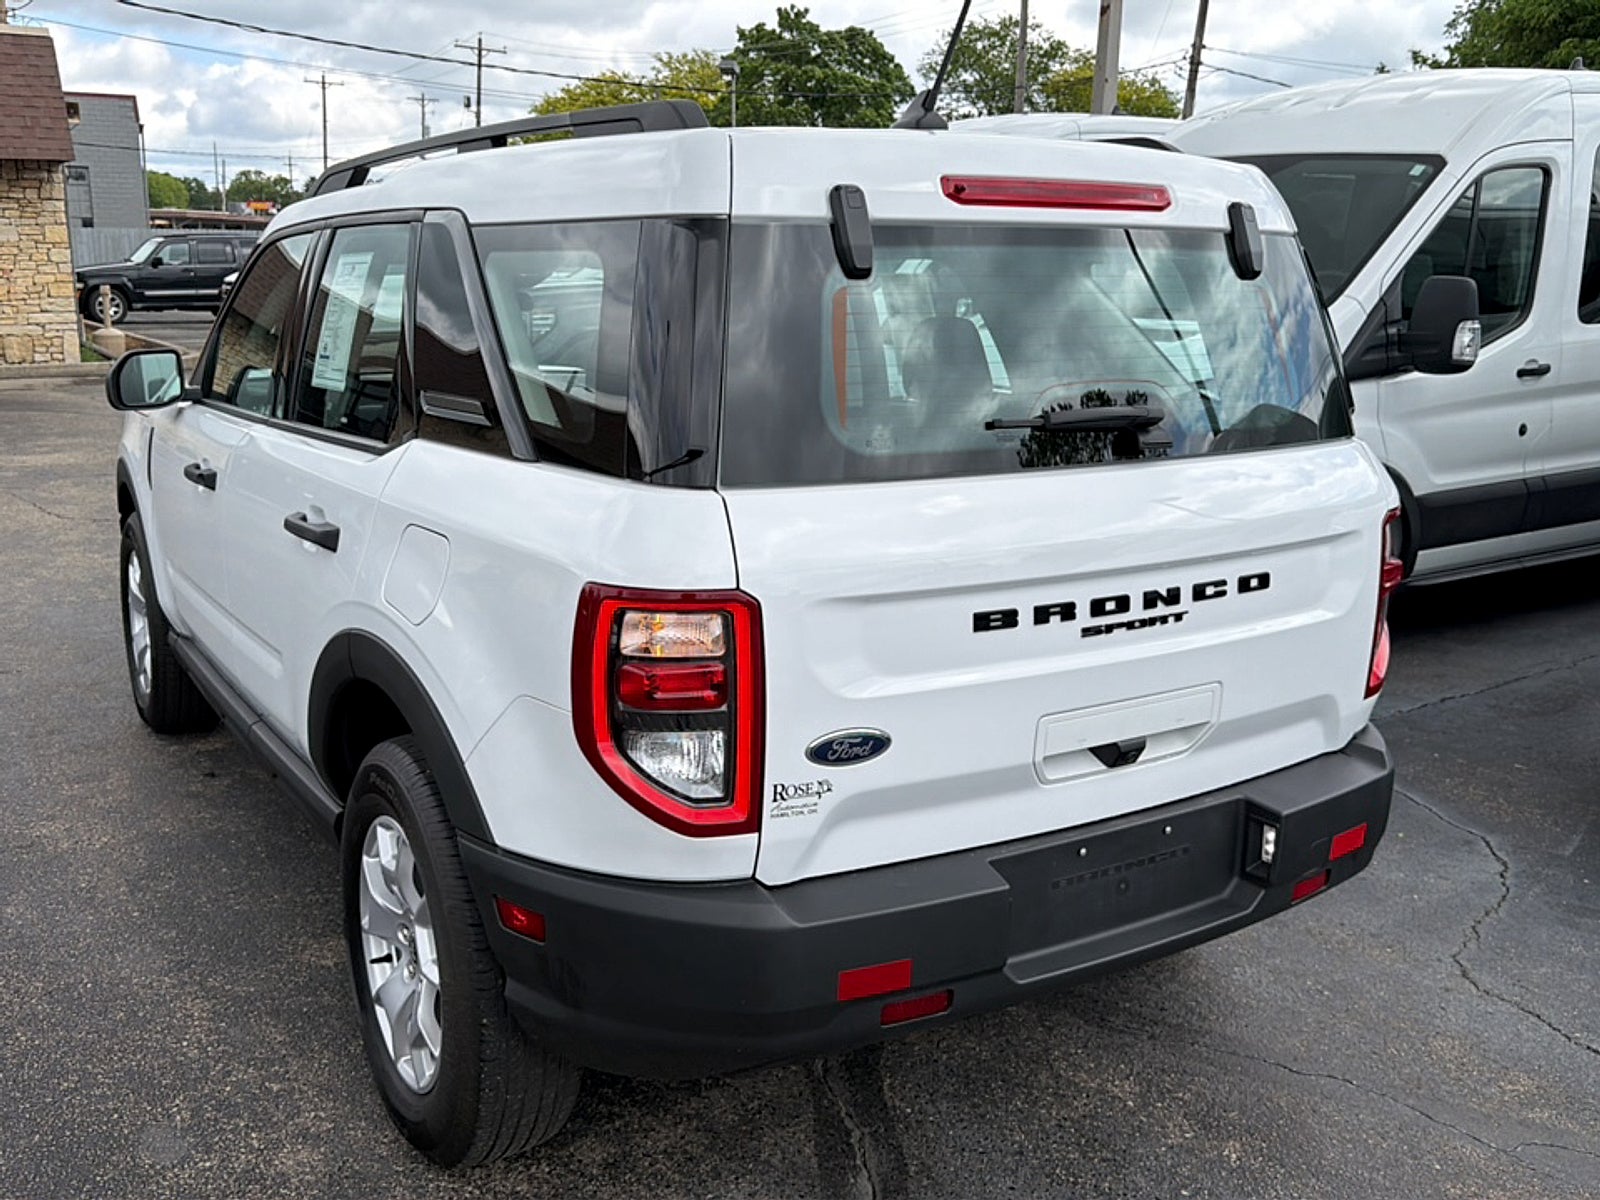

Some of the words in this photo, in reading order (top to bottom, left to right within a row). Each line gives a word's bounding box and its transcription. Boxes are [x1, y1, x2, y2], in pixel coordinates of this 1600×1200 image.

[973, 572, 1270, 632] BRONCO
[1080, 611, 1189, 638] SPORT
[827, 737, 876, 760] Ford
[771, 782, 815, 802] ROSE
[1052, 845, 1190, 889] BRONCO
